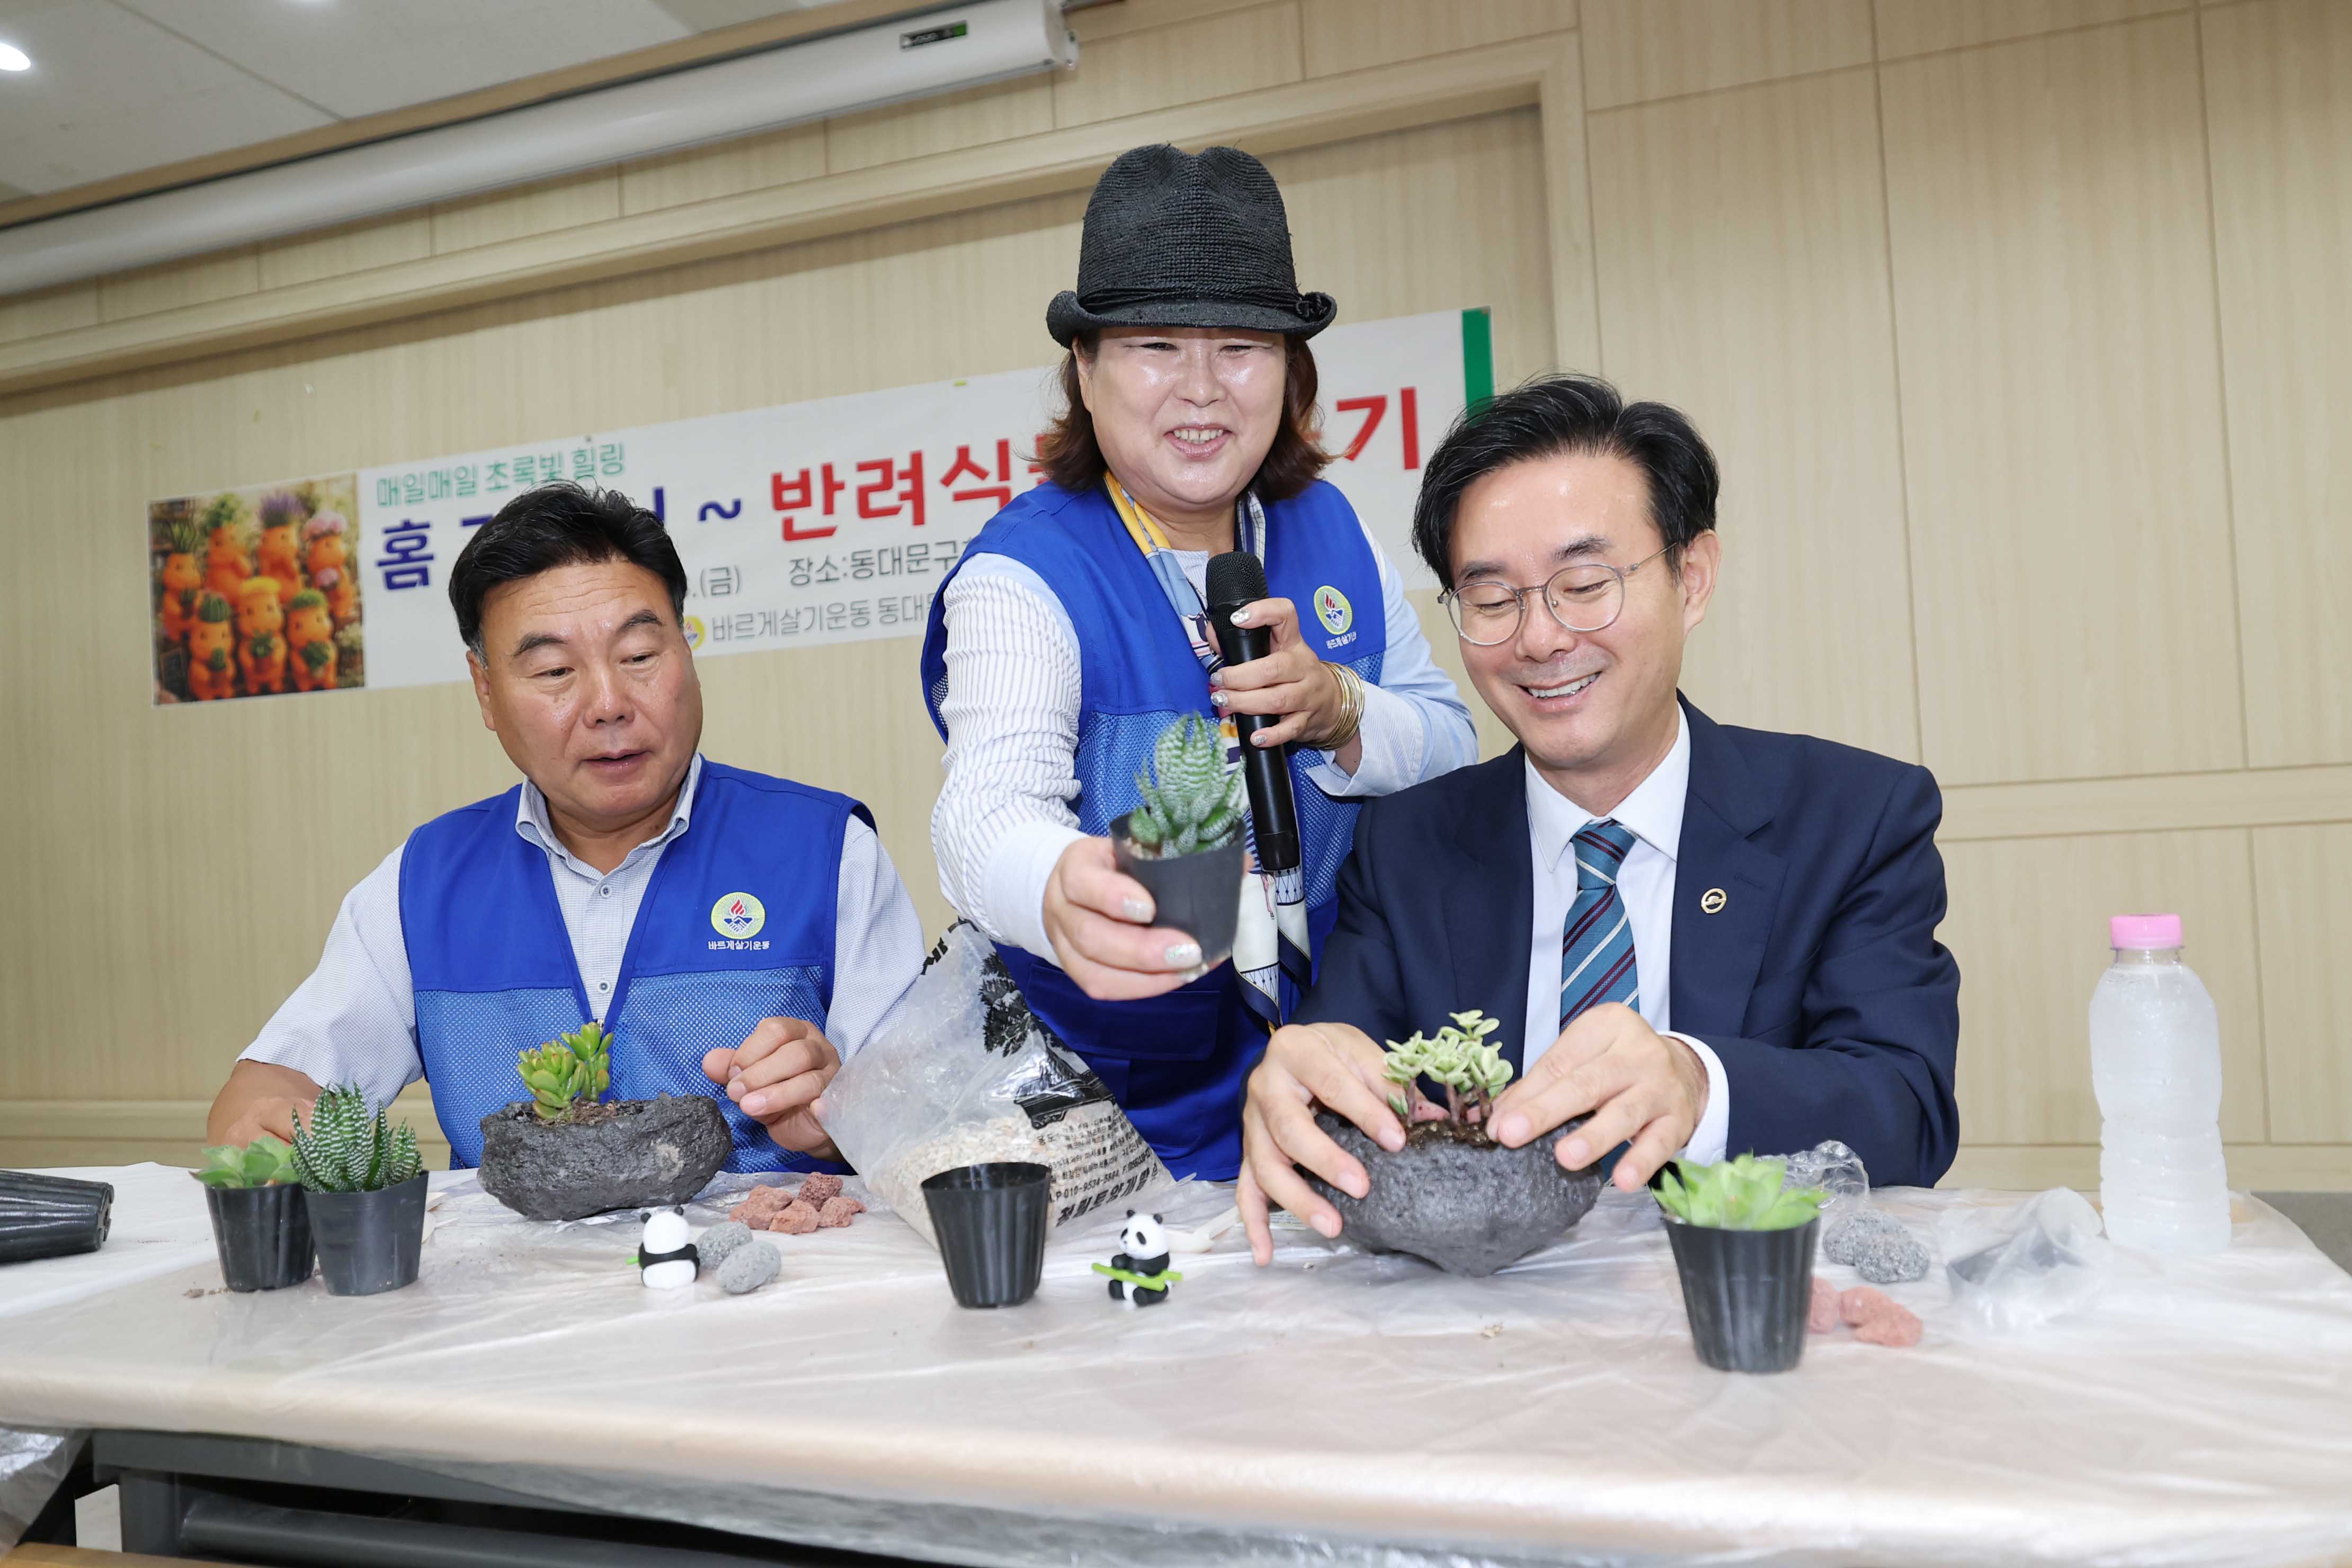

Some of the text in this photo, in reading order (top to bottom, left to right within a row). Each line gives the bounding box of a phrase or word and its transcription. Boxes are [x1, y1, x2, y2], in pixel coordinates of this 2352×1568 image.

[377, 443, 626, 507] 매일매일 초록빛 힐링
[771, 433, 1052, 542] 반려식
[1305, 387, 1421, 470] 기
[685, 537, 970, 598] .(금) 장소:동대문구
[711, 599, 871, 642] 바르게살기운동
[708, 940, 770, 950] 바르게살기운동
